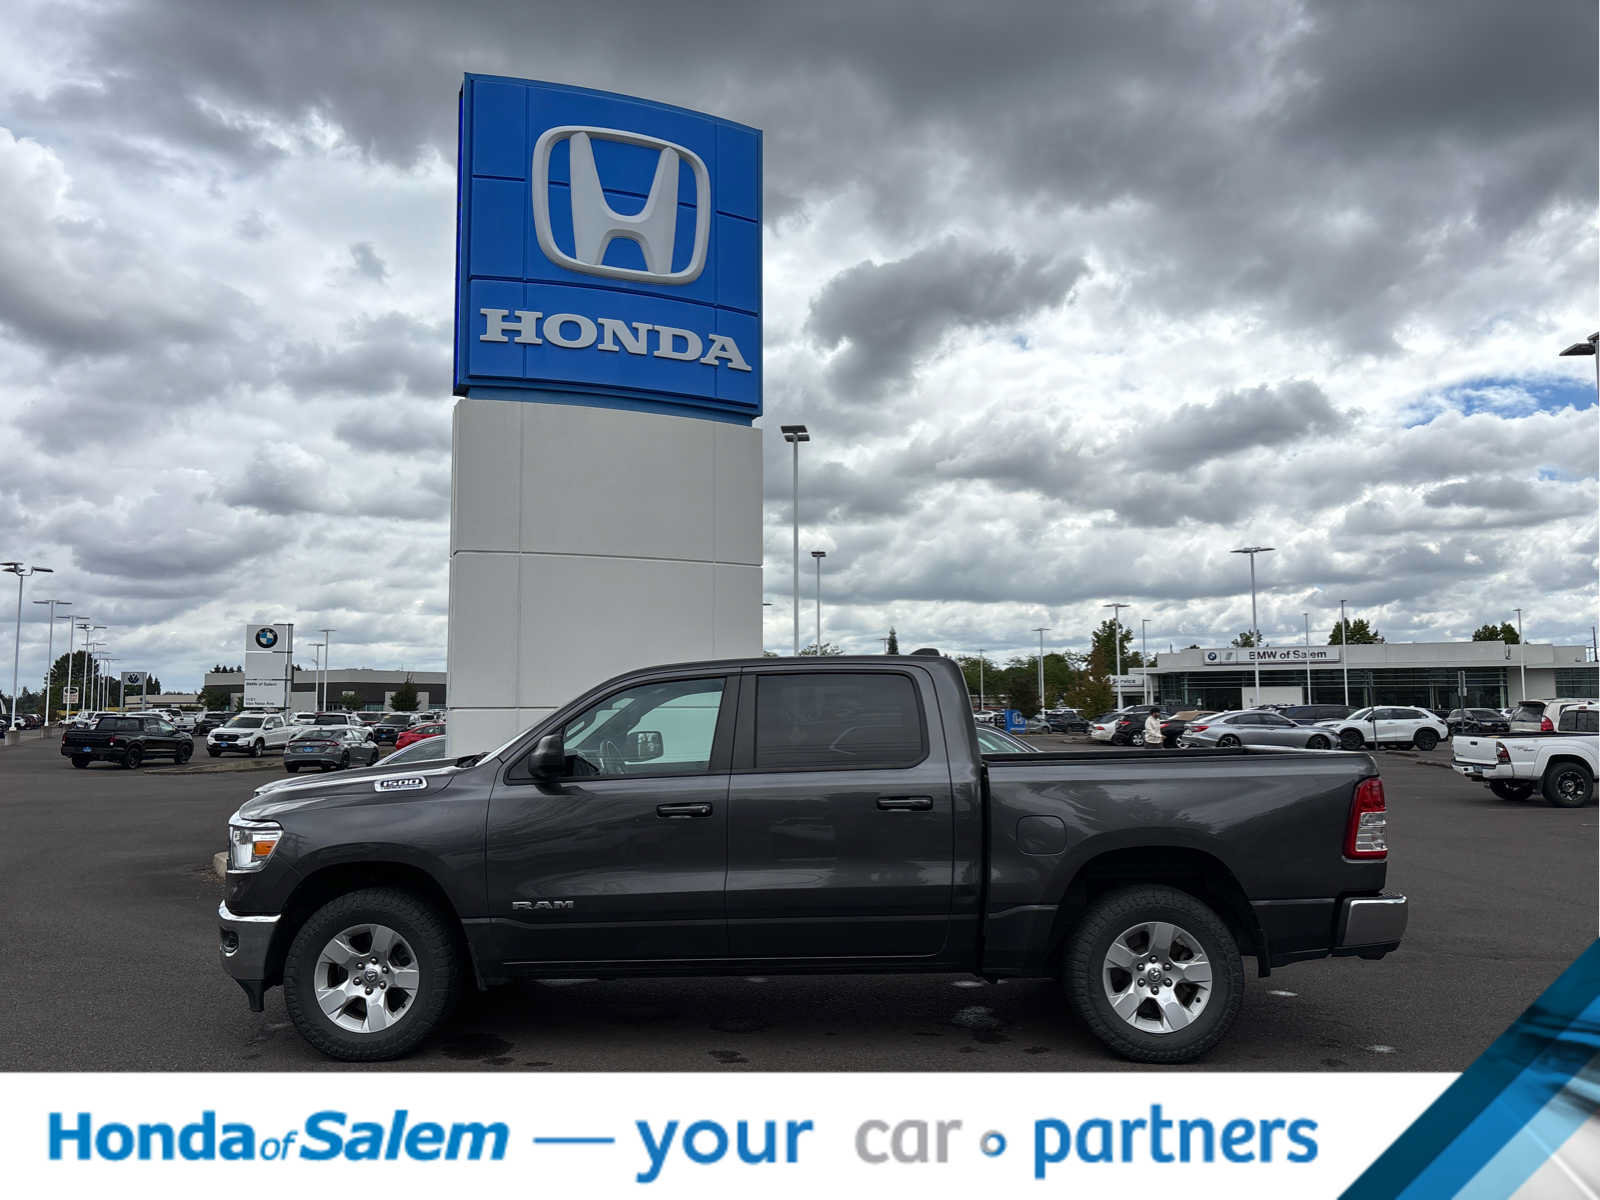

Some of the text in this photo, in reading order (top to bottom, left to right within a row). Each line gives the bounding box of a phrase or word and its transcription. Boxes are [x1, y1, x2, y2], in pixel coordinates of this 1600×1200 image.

[480, 308, 752, 372] HONDA
[1249, 651, 1277, 659] BMW
[1280, 650, 1291, 659] of
[383, 779, 421, 787] 1500
[512, 901, 574, 910] RAM
